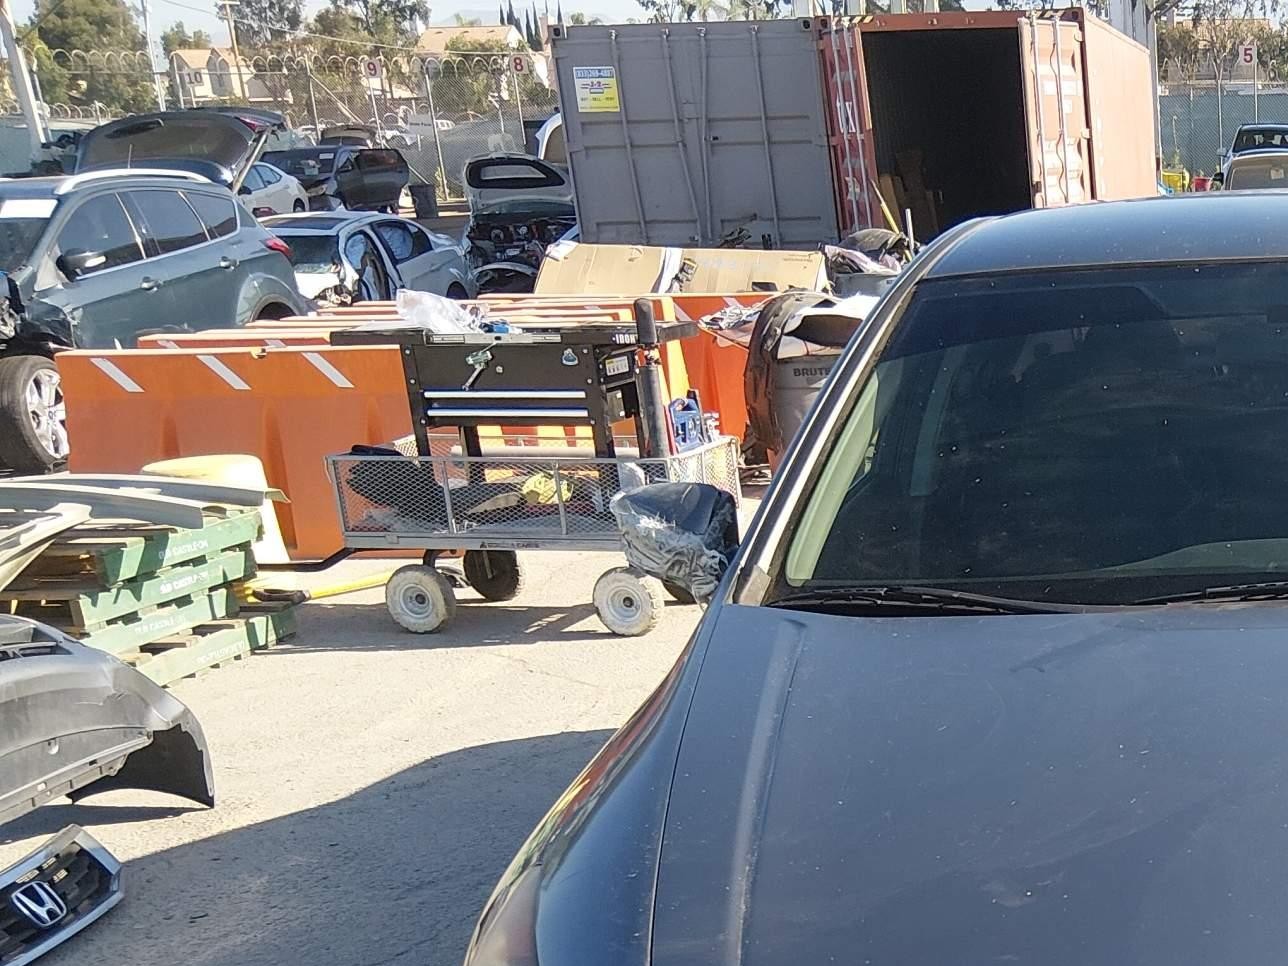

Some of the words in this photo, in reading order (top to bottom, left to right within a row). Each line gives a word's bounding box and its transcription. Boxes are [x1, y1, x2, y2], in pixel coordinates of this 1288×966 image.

[1243, 47, 1253, 63] 5
[366, 61, 378, 77] 9
[512, 56, 524, 72] 8
[186, 71, 203, 85] 10
